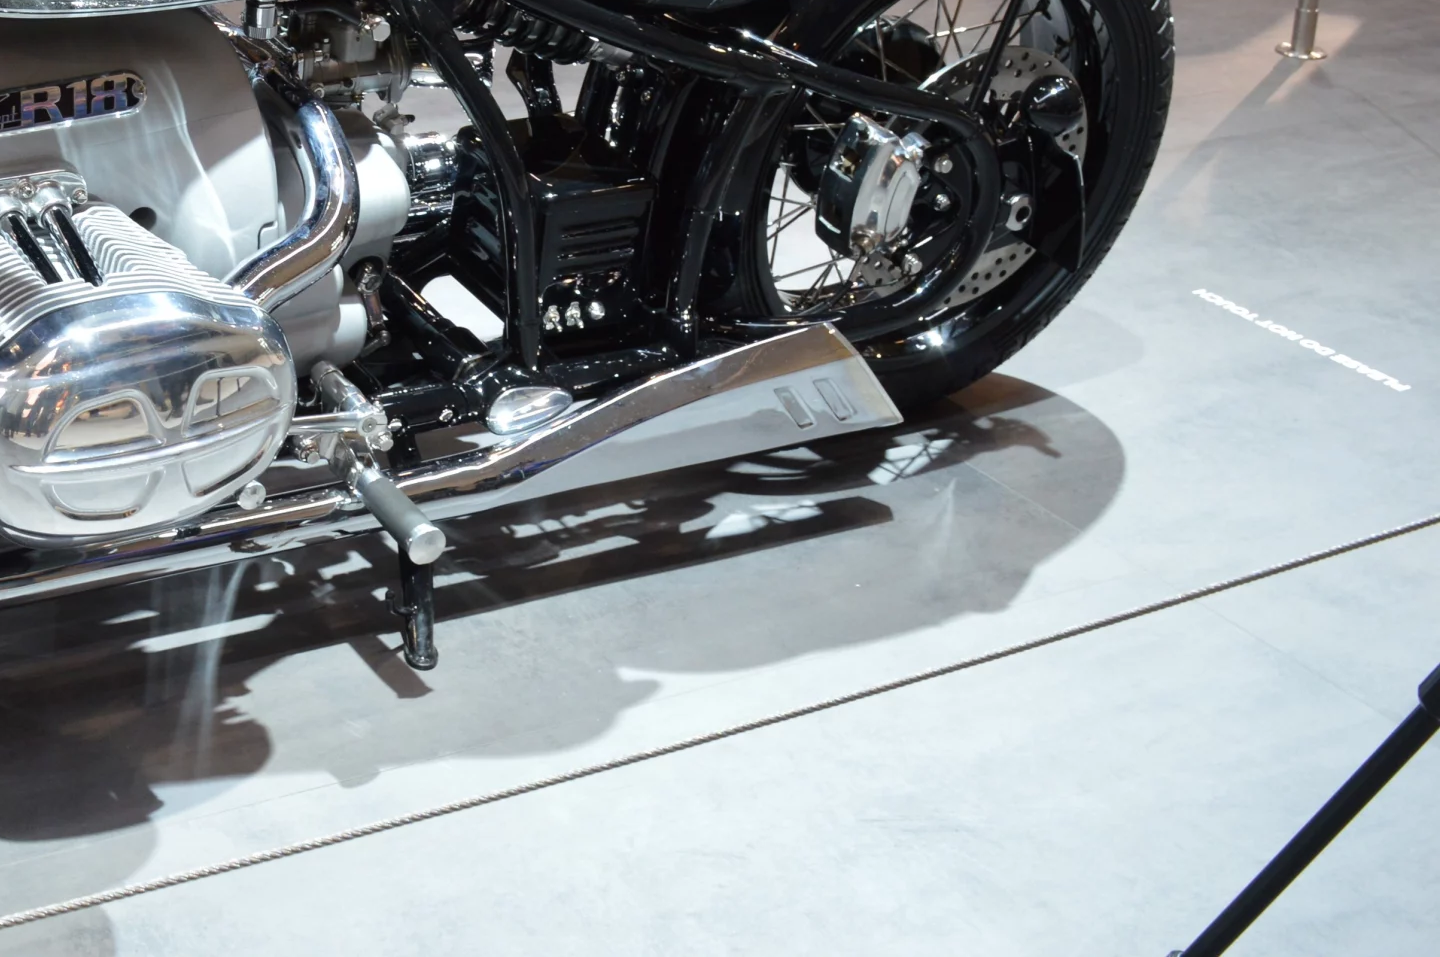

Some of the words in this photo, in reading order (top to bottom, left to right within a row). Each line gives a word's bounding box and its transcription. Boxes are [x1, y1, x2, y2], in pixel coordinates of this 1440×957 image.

[20, 73, 129, 127] R18
[1191, 288, 1259, 322] TOUCH
[1254, 320, 1304, 341] NOT
[1299, 339, 1336, 356] DO
[1329, 354, 1411, 392] PLEASE
